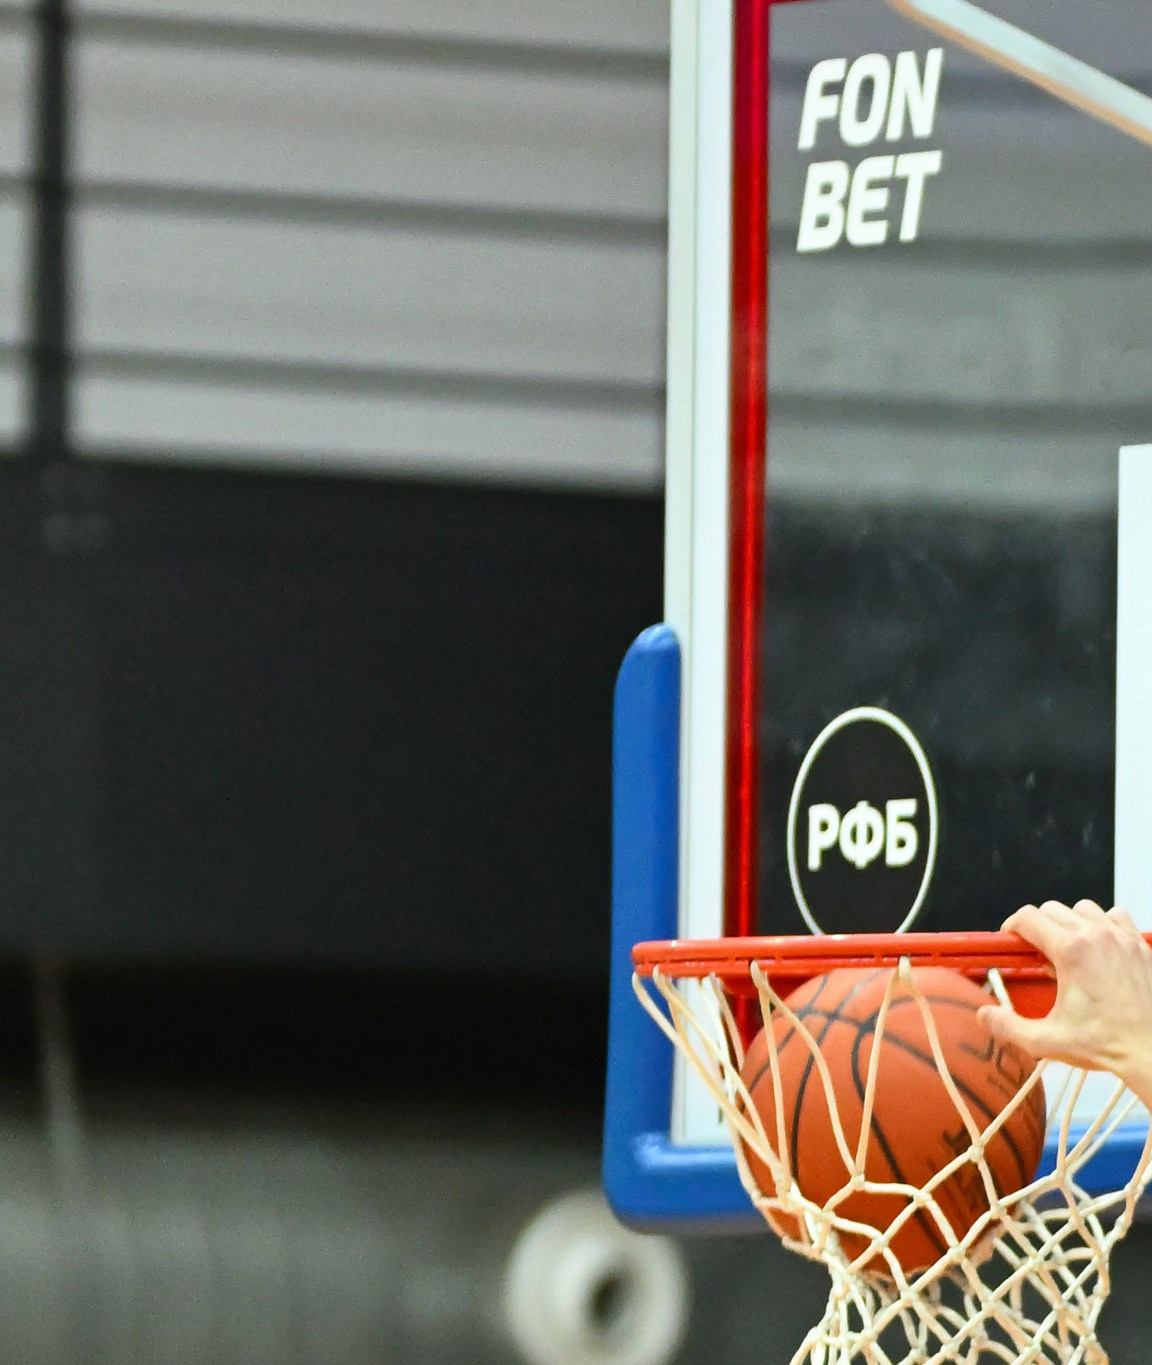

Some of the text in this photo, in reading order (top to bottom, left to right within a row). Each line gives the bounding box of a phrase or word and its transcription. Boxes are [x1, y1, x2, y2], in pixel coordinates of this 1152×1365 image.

[798, 47, 944, 150] FON
[797, 150, 942, 254] BET
[807, 798, 919, 872] РФБ
